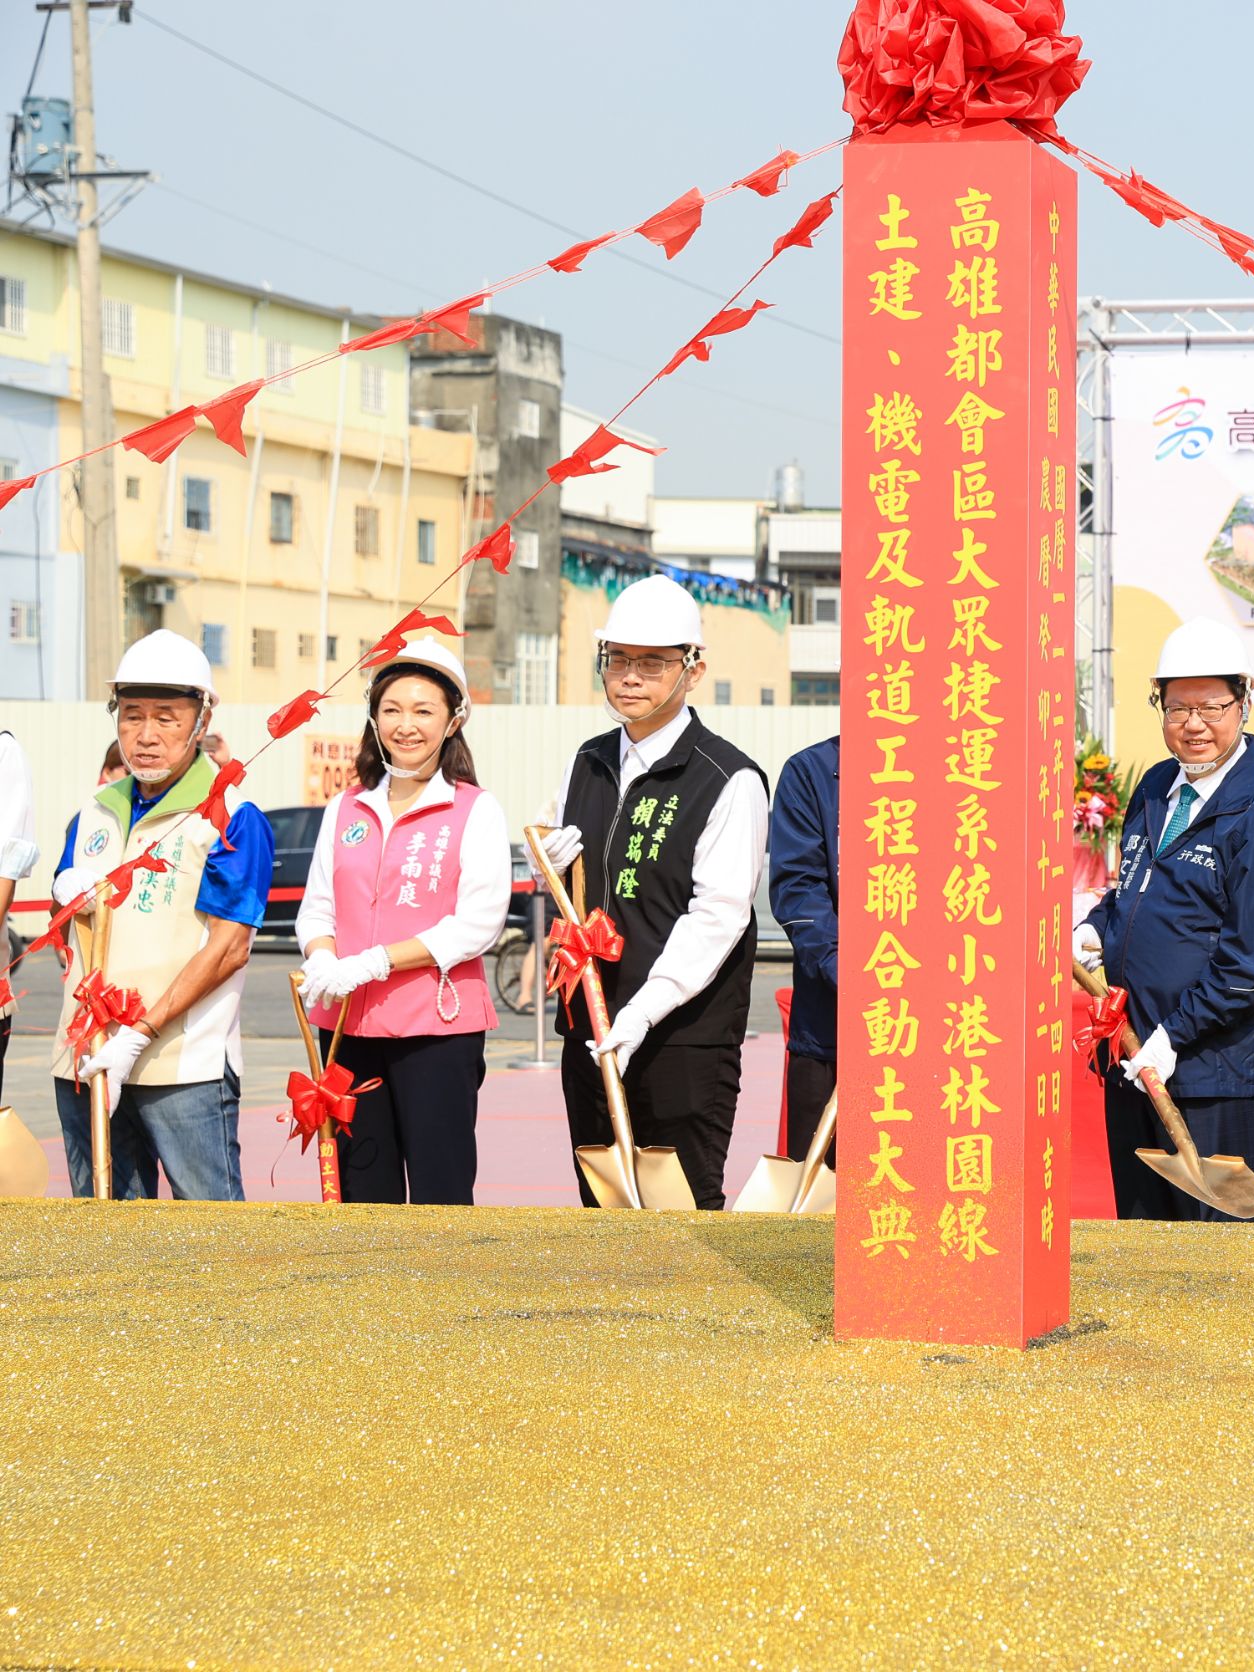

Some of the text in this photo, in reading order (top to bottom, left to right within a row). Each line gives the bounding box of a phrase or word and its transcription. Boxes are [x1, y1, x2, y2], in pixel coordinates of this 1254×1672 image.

[1047, 200, 1060, 439] 中華民國
[859, 193, 926, 1260] 土建、機電及軌道工程聯合動土大典
[938, 187, 1005, 1263] 高雄都會區大眾捷運系統小港林園線
[395, 831, 427, 908] 李雨庭
[427, 825, 451, 894] 高雄市議員
[615, 796, 659, 899] 賴瑞隆
[647, 794, 680, 861] 立法委員
[1177, 849, 1217, 871] 行政院
[1041, 1137, 1054, 1250] 吉時
